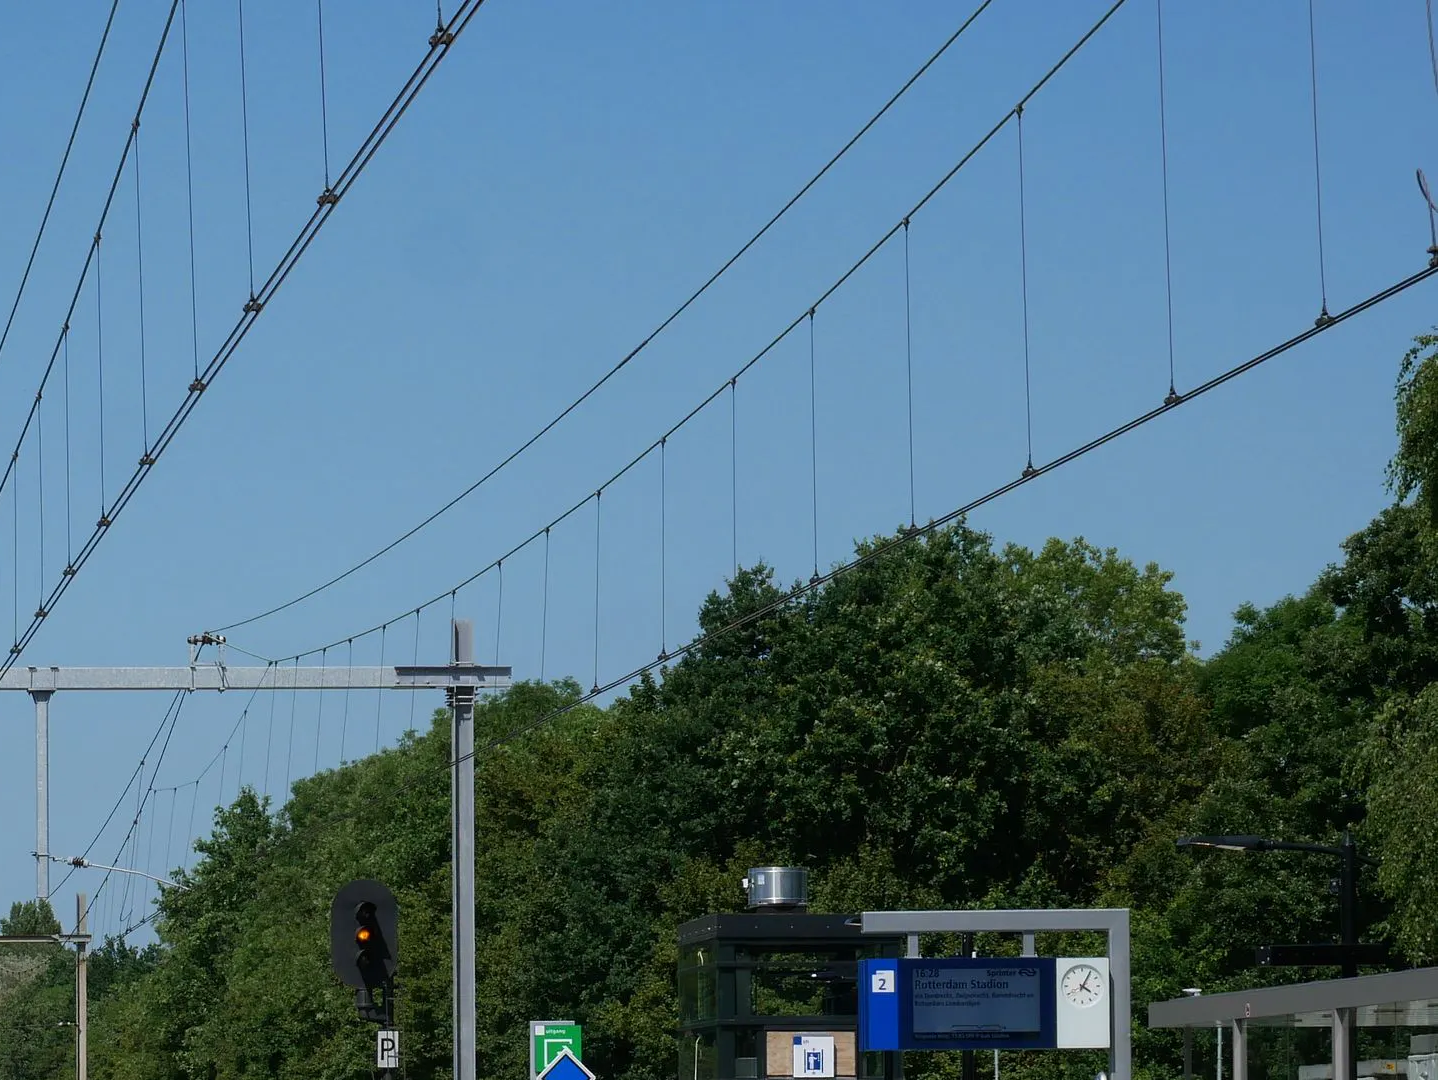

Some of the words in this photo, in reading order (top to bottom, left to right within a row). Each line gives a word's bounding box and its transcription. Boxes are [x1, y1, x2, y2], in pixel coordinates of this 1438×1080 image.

[915, 969, 940, 978] 16:28
[986, 969, 1016, 977] Sprinter
[878, 978, 887, 991] 2
[914, 979, 968, 990] Rotterdam
[970, 979, 1009, 989] Stadion
[381, 1038, 395, 1060] P
